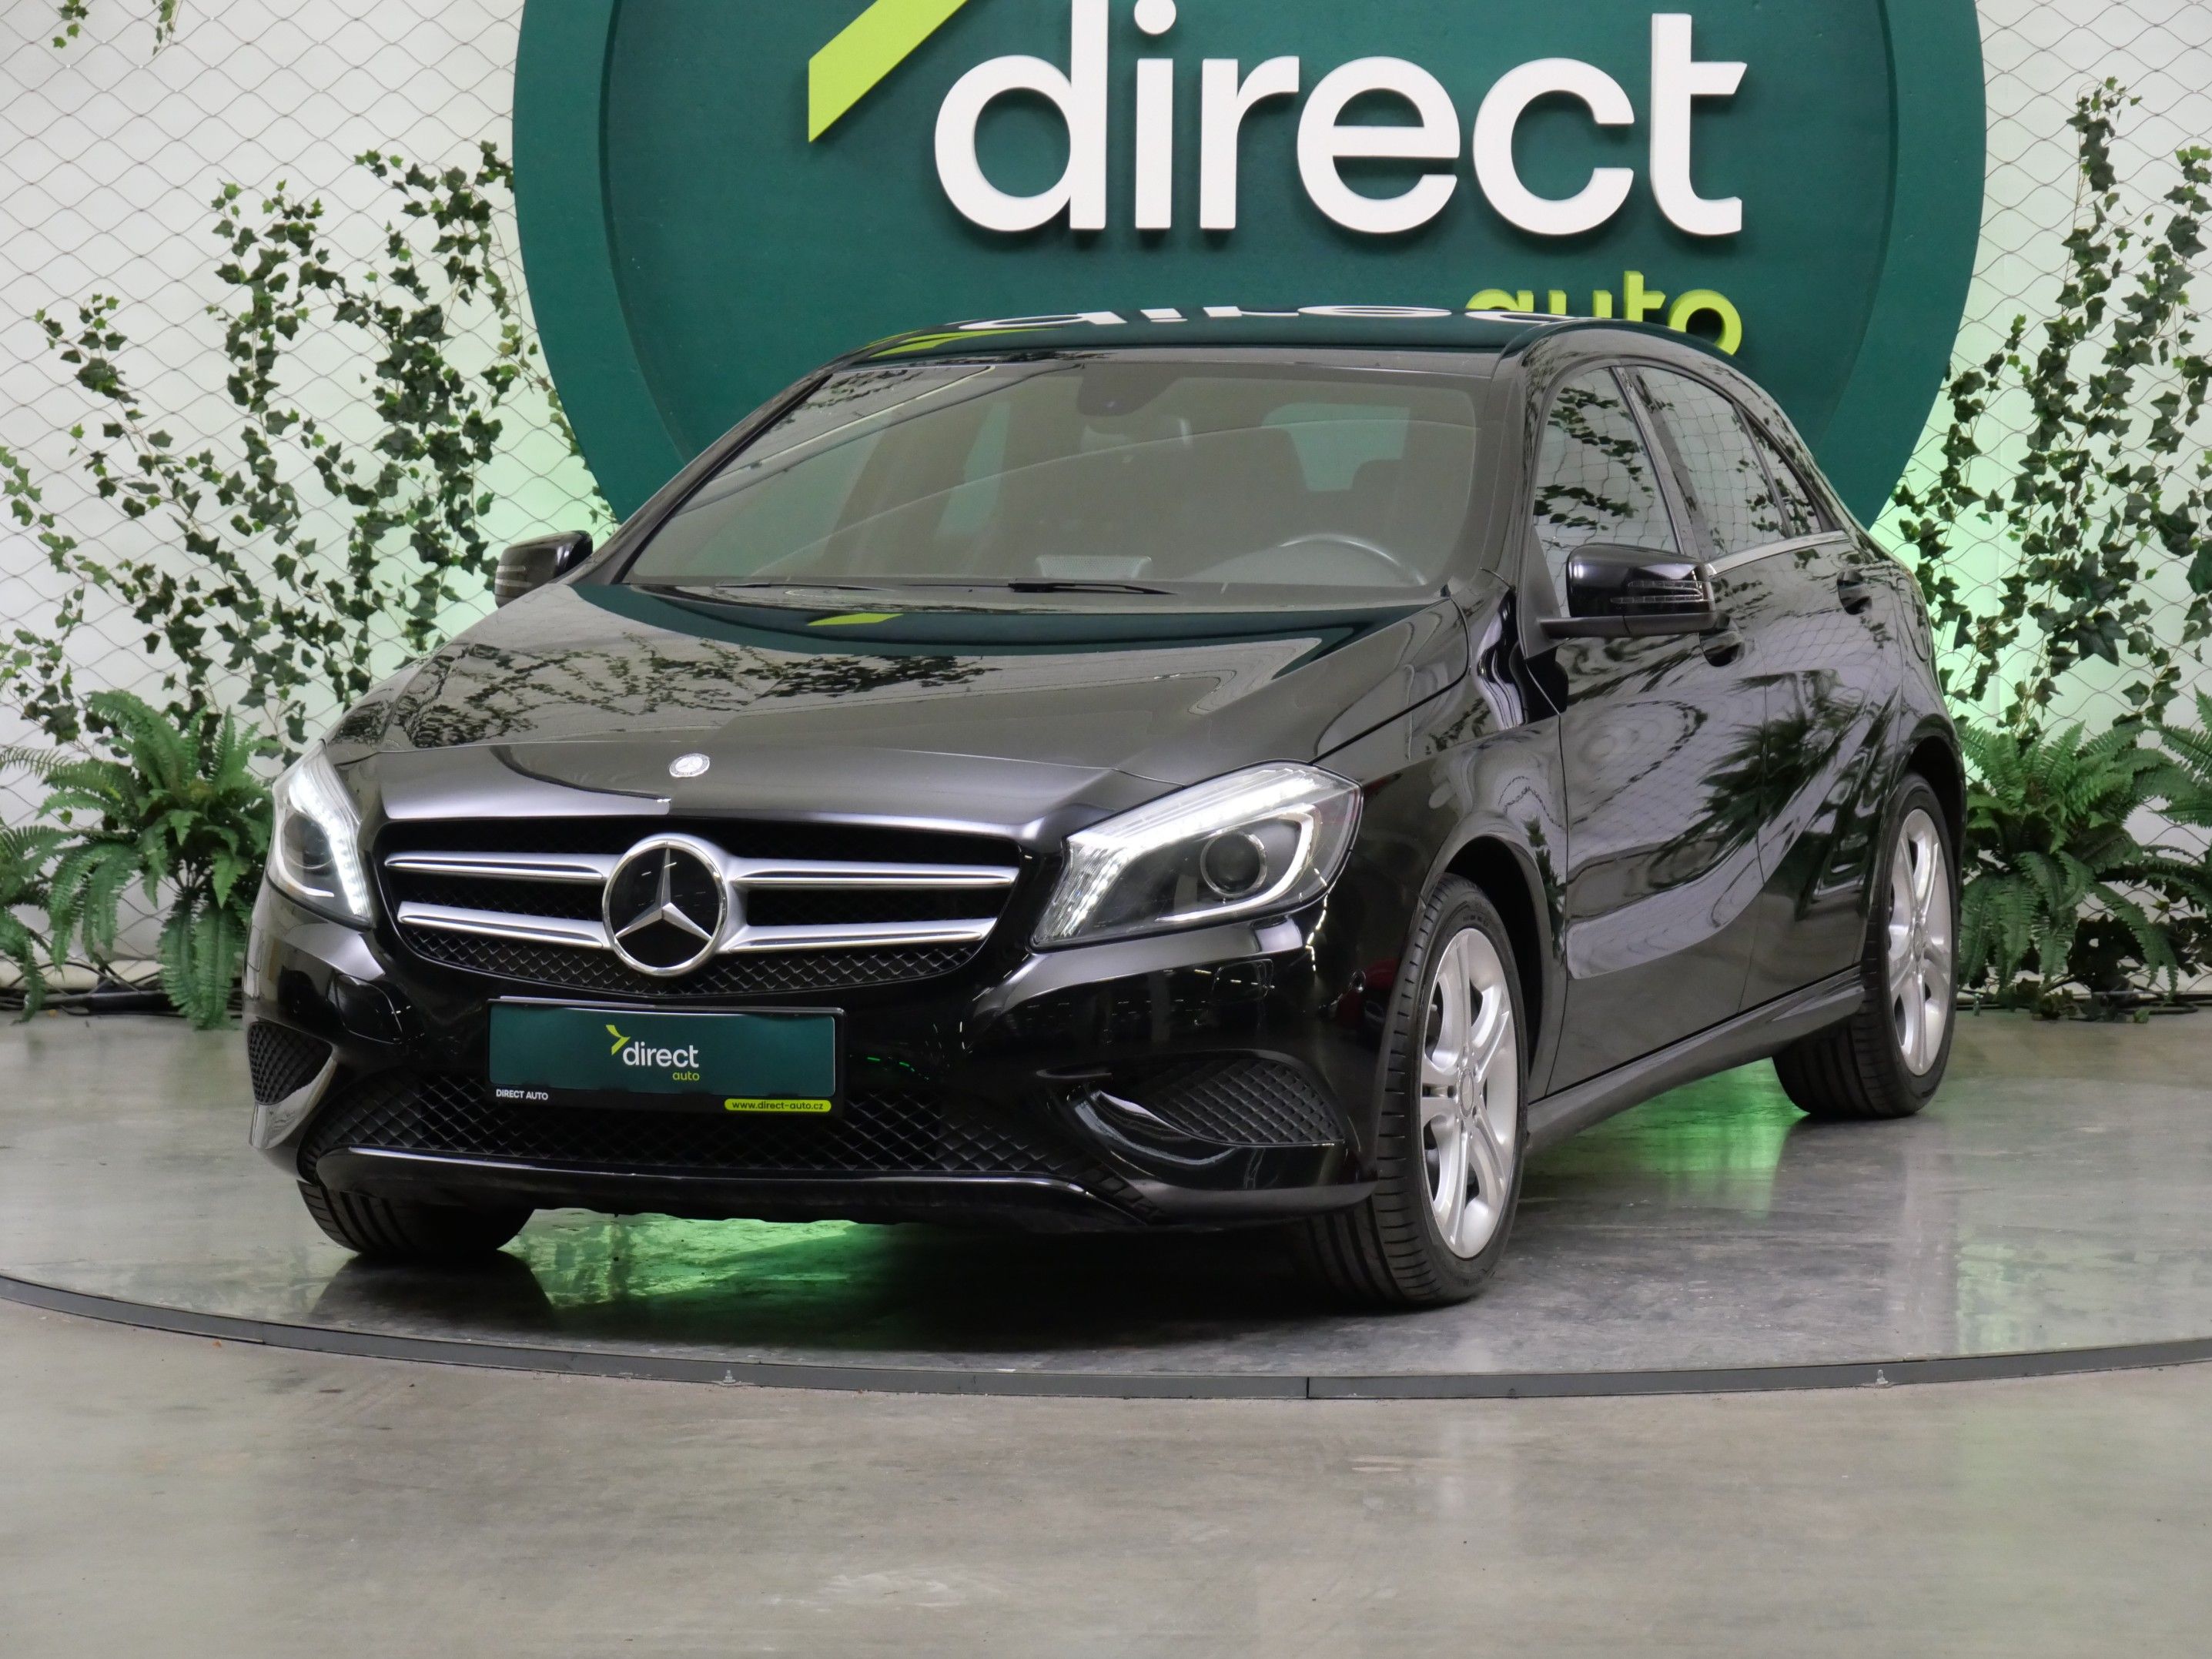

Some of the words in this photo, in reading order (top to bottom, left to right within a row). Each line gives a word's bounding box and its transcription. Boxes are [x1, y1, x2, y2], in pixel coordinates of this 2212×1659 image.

[935, 0, 1747, 235] direct
[622, 1041, 700, 1068] direct
[672, 1071, 700, 1081] auto
[496, 1089, 525, 1099] DIRECT
[526, 1091, 548, 1100] AUTO
[731, 1101, 824, 1110] www.direct-auto.cz
